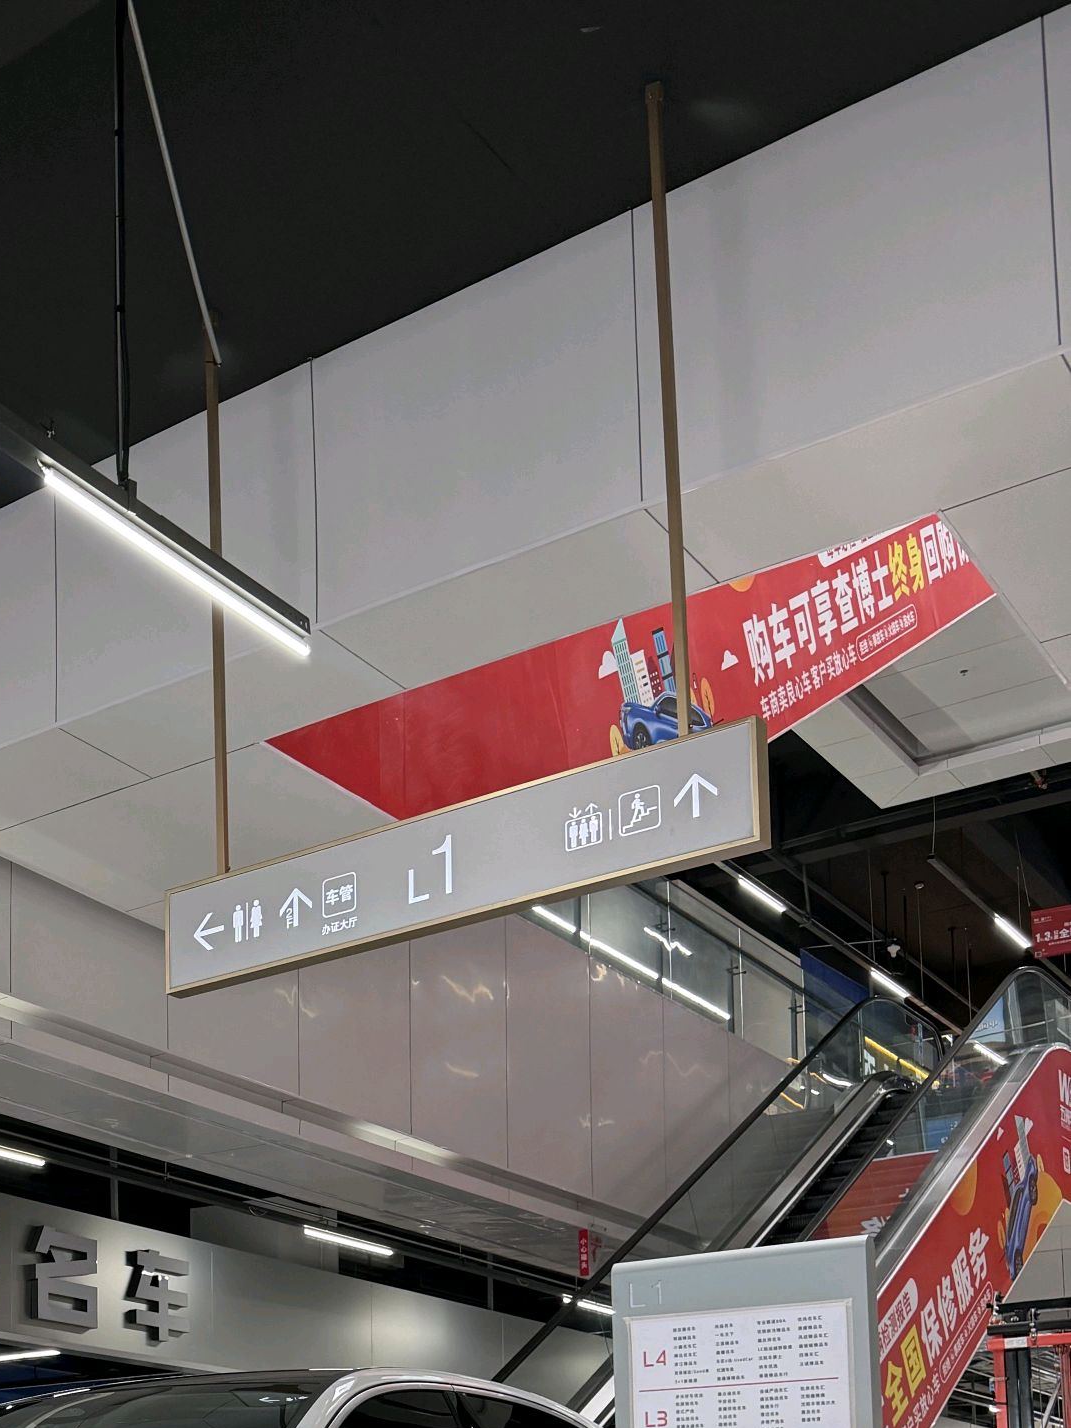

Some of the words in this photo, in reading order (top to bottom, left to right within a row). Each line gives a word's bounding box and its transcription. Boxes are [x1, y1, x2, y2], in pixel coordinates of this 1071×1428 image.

[408, 834, 452, 904] L1
[325, 884, 353, 905] 车管
[321, 917, 357, 936] 办证大厅
[629, 1279, 662, 1308] L1
[643, 1350, 667, 1367] L4
[644, 1410, 668, 1428] L3
